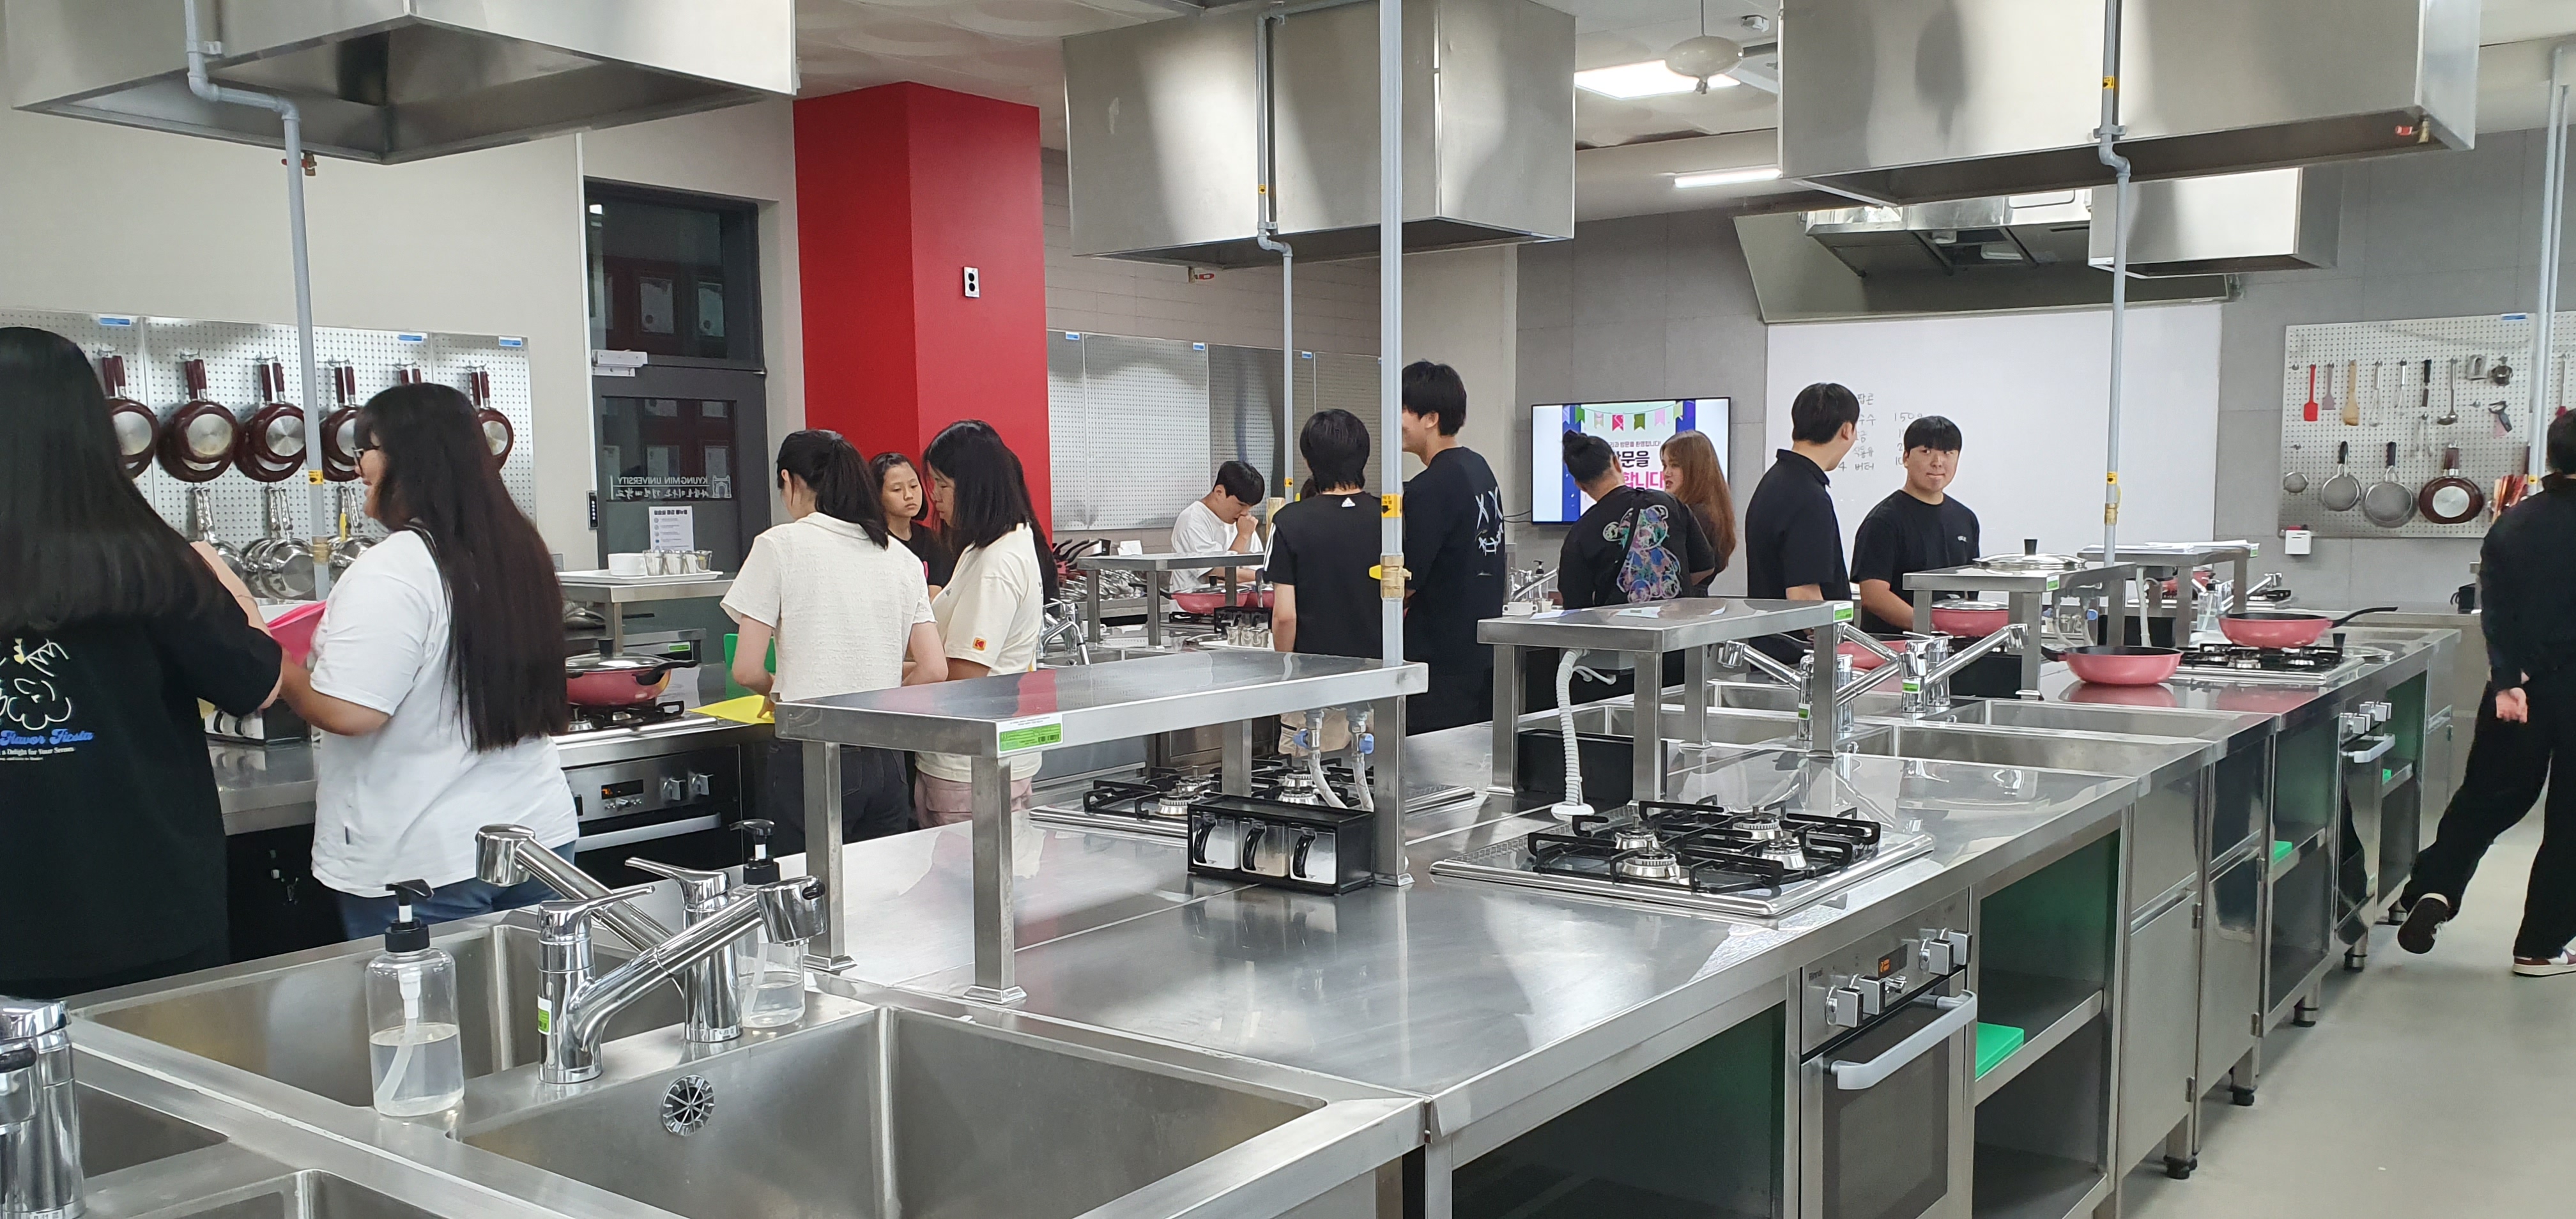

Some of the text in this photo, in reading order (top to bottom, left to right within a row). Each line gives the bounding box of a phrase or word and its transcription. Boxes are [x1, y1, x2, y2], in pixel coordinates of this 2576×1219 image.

[1855, 462, 1874, 471] 버터
[0, 728, 95, 746] Flavor Fiesta
